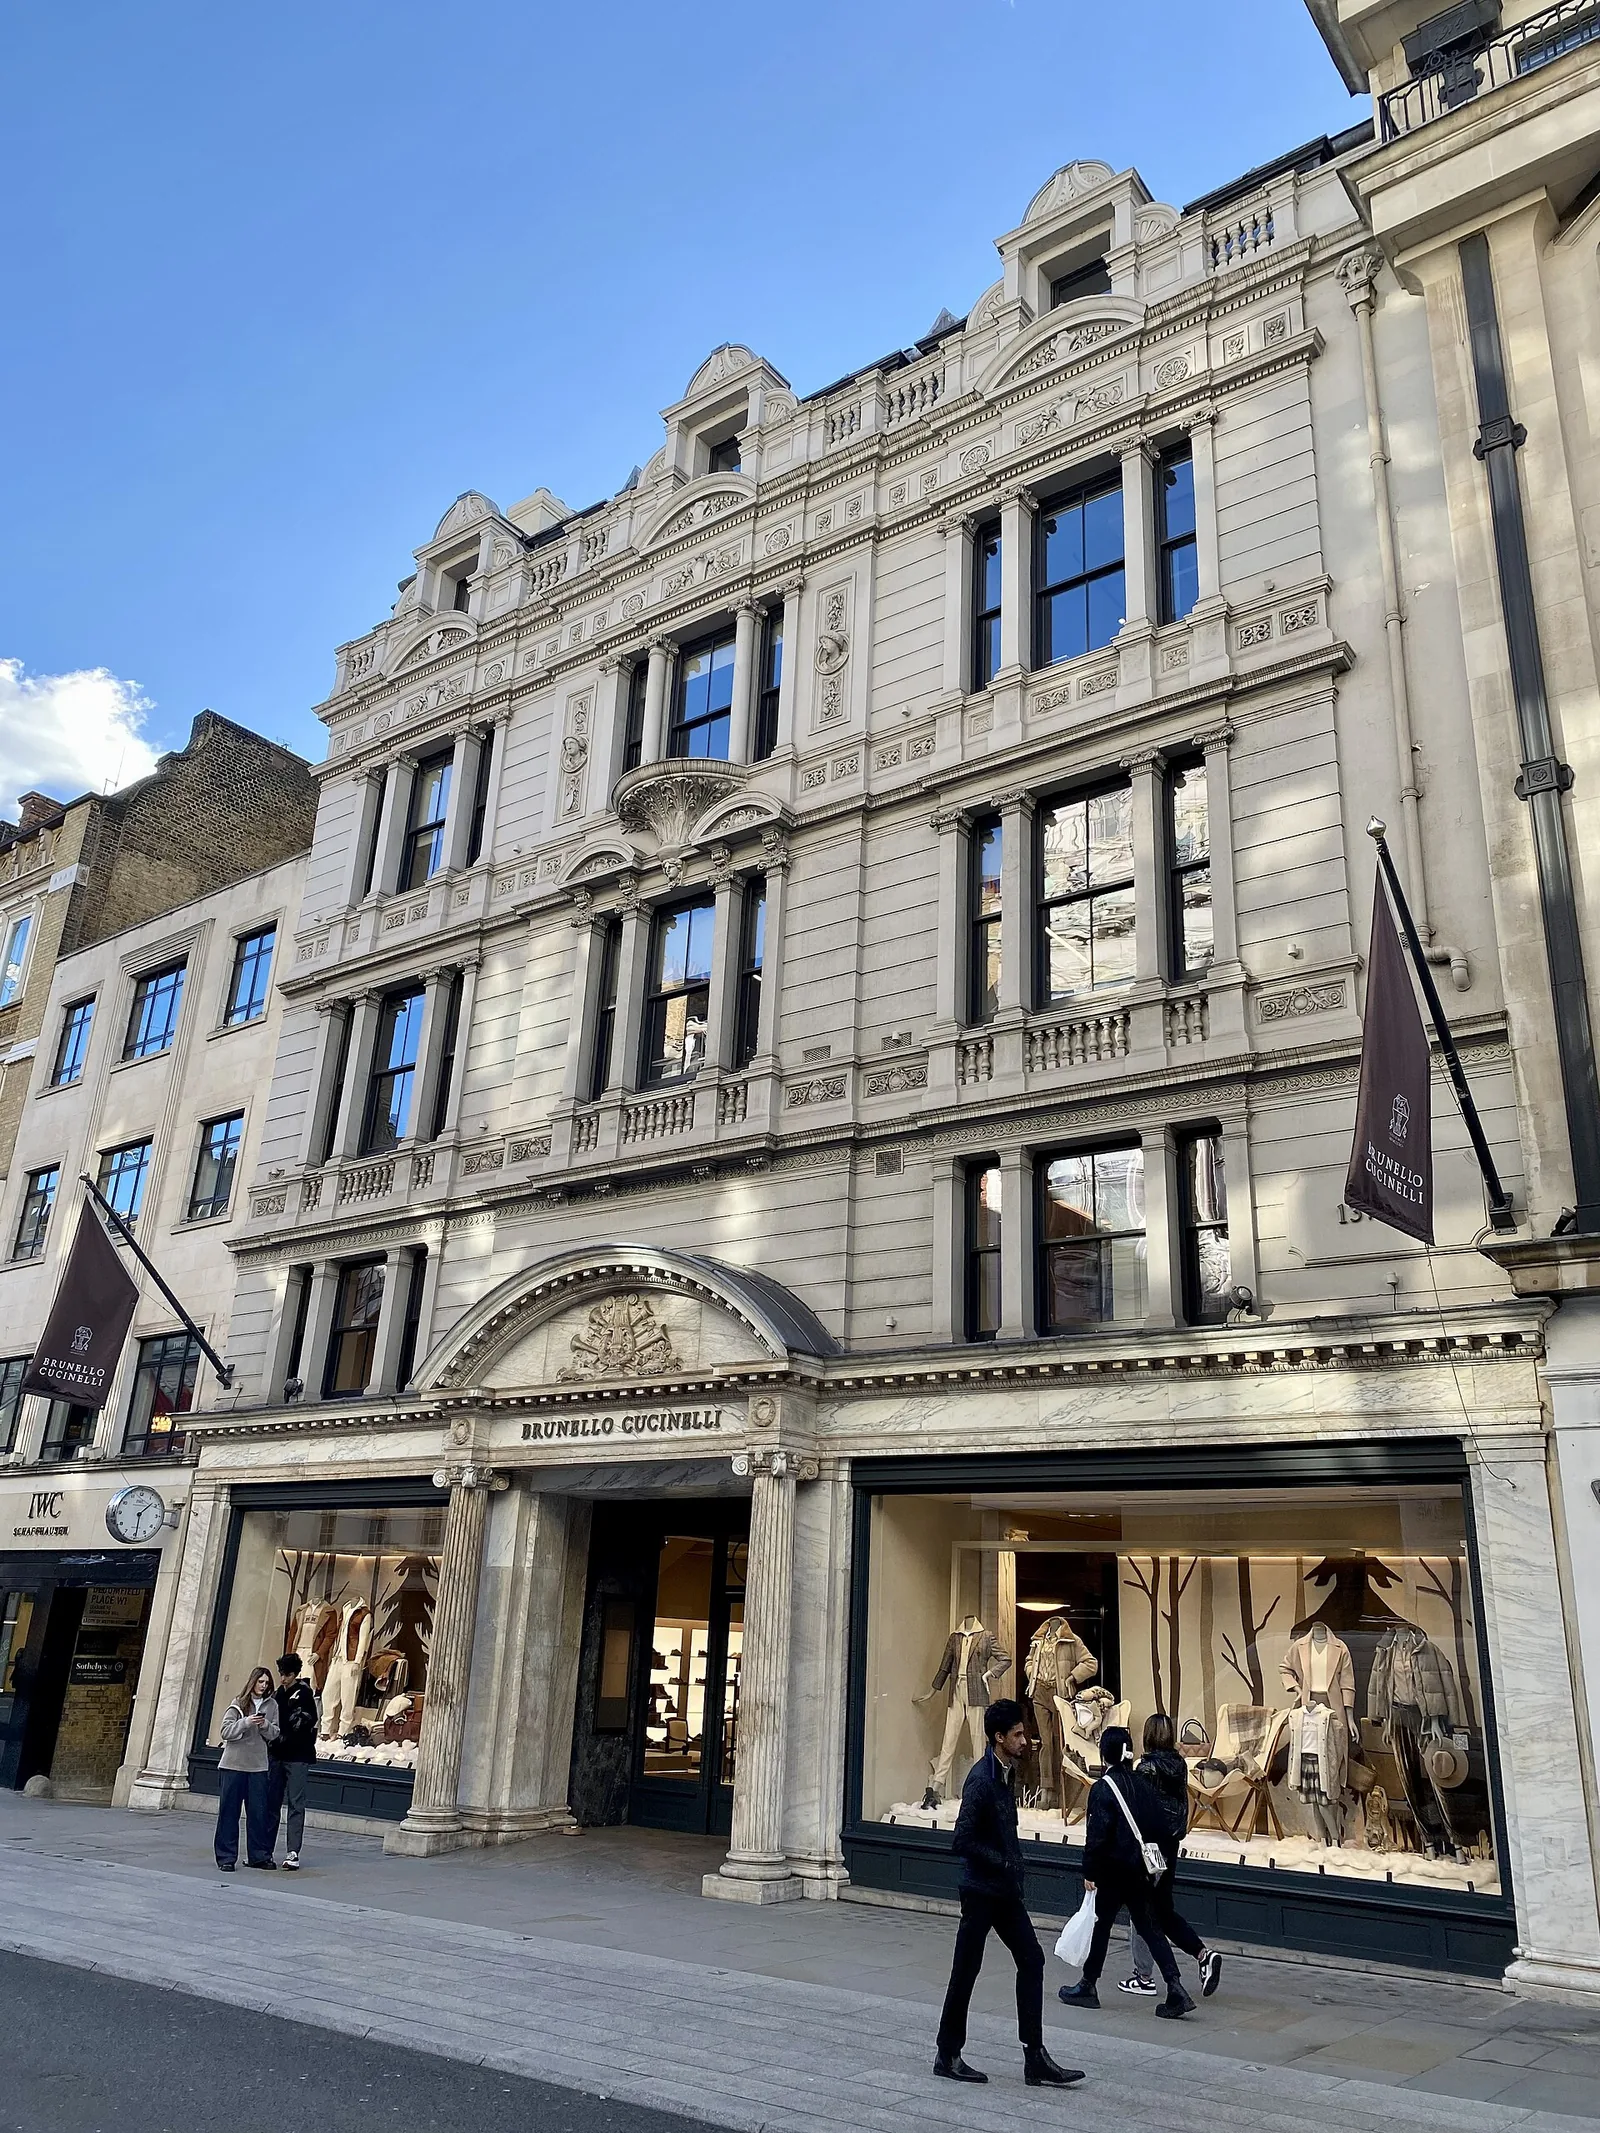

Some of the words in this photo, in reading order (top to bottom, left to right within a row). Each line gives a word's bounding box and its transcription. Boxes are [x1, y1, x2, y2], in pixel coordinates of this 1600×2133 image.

[1365, 1158, 1424, 1205] CUCINELLI
[39, 1367, 103, 1387] CUCINELLI
[43, 1357, 106, 1377] BRUNELLO
[521, 1417, 614, 1440] BRUNELLO
[621, 1410, 722, 1434] CUCINELLI
[28, 1491, 64, 1519] IWC
[12, 1526, 69, 1537] SCHAFFHAUSEN
[90, 1595, 115, 1605] PLACE
